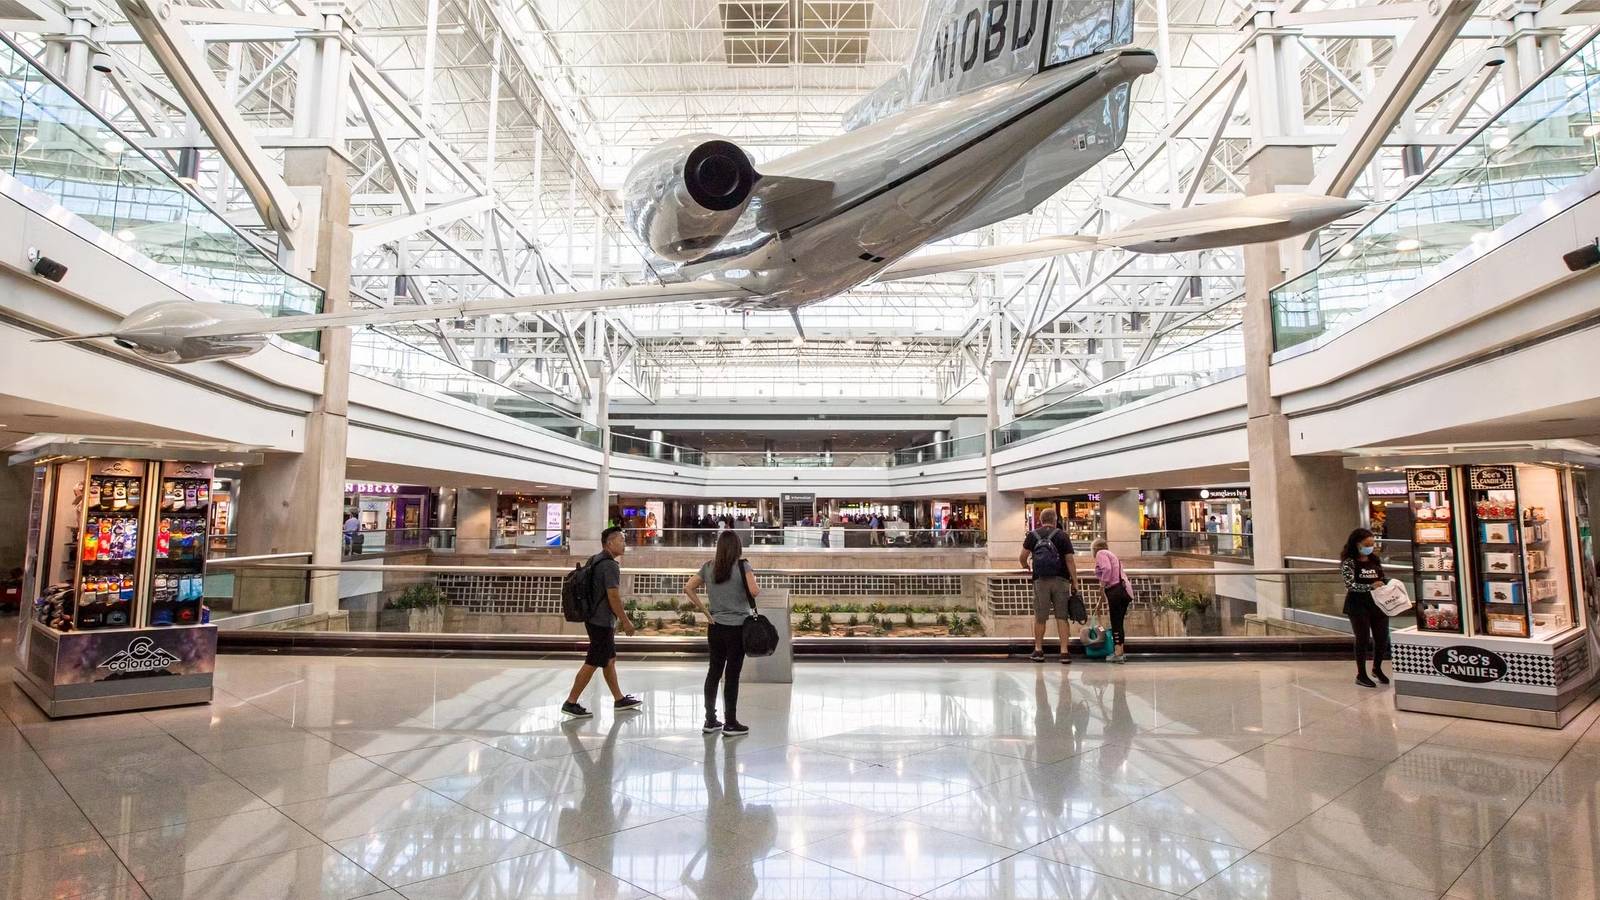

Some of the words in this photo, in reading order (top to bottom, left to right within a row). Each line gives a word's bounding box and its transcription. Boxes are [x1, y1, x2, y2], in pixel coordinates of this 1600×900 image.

[1482, 471, 1500, 479] See's
[357, 483, 399, 493] DECAY
[1210, 490, 1236, 498] sunglass
[109, 656, 171, 671] colorado
[1447, 649, 1491, 666] See's
[1441, 664, 1499, 678] CANDIES
